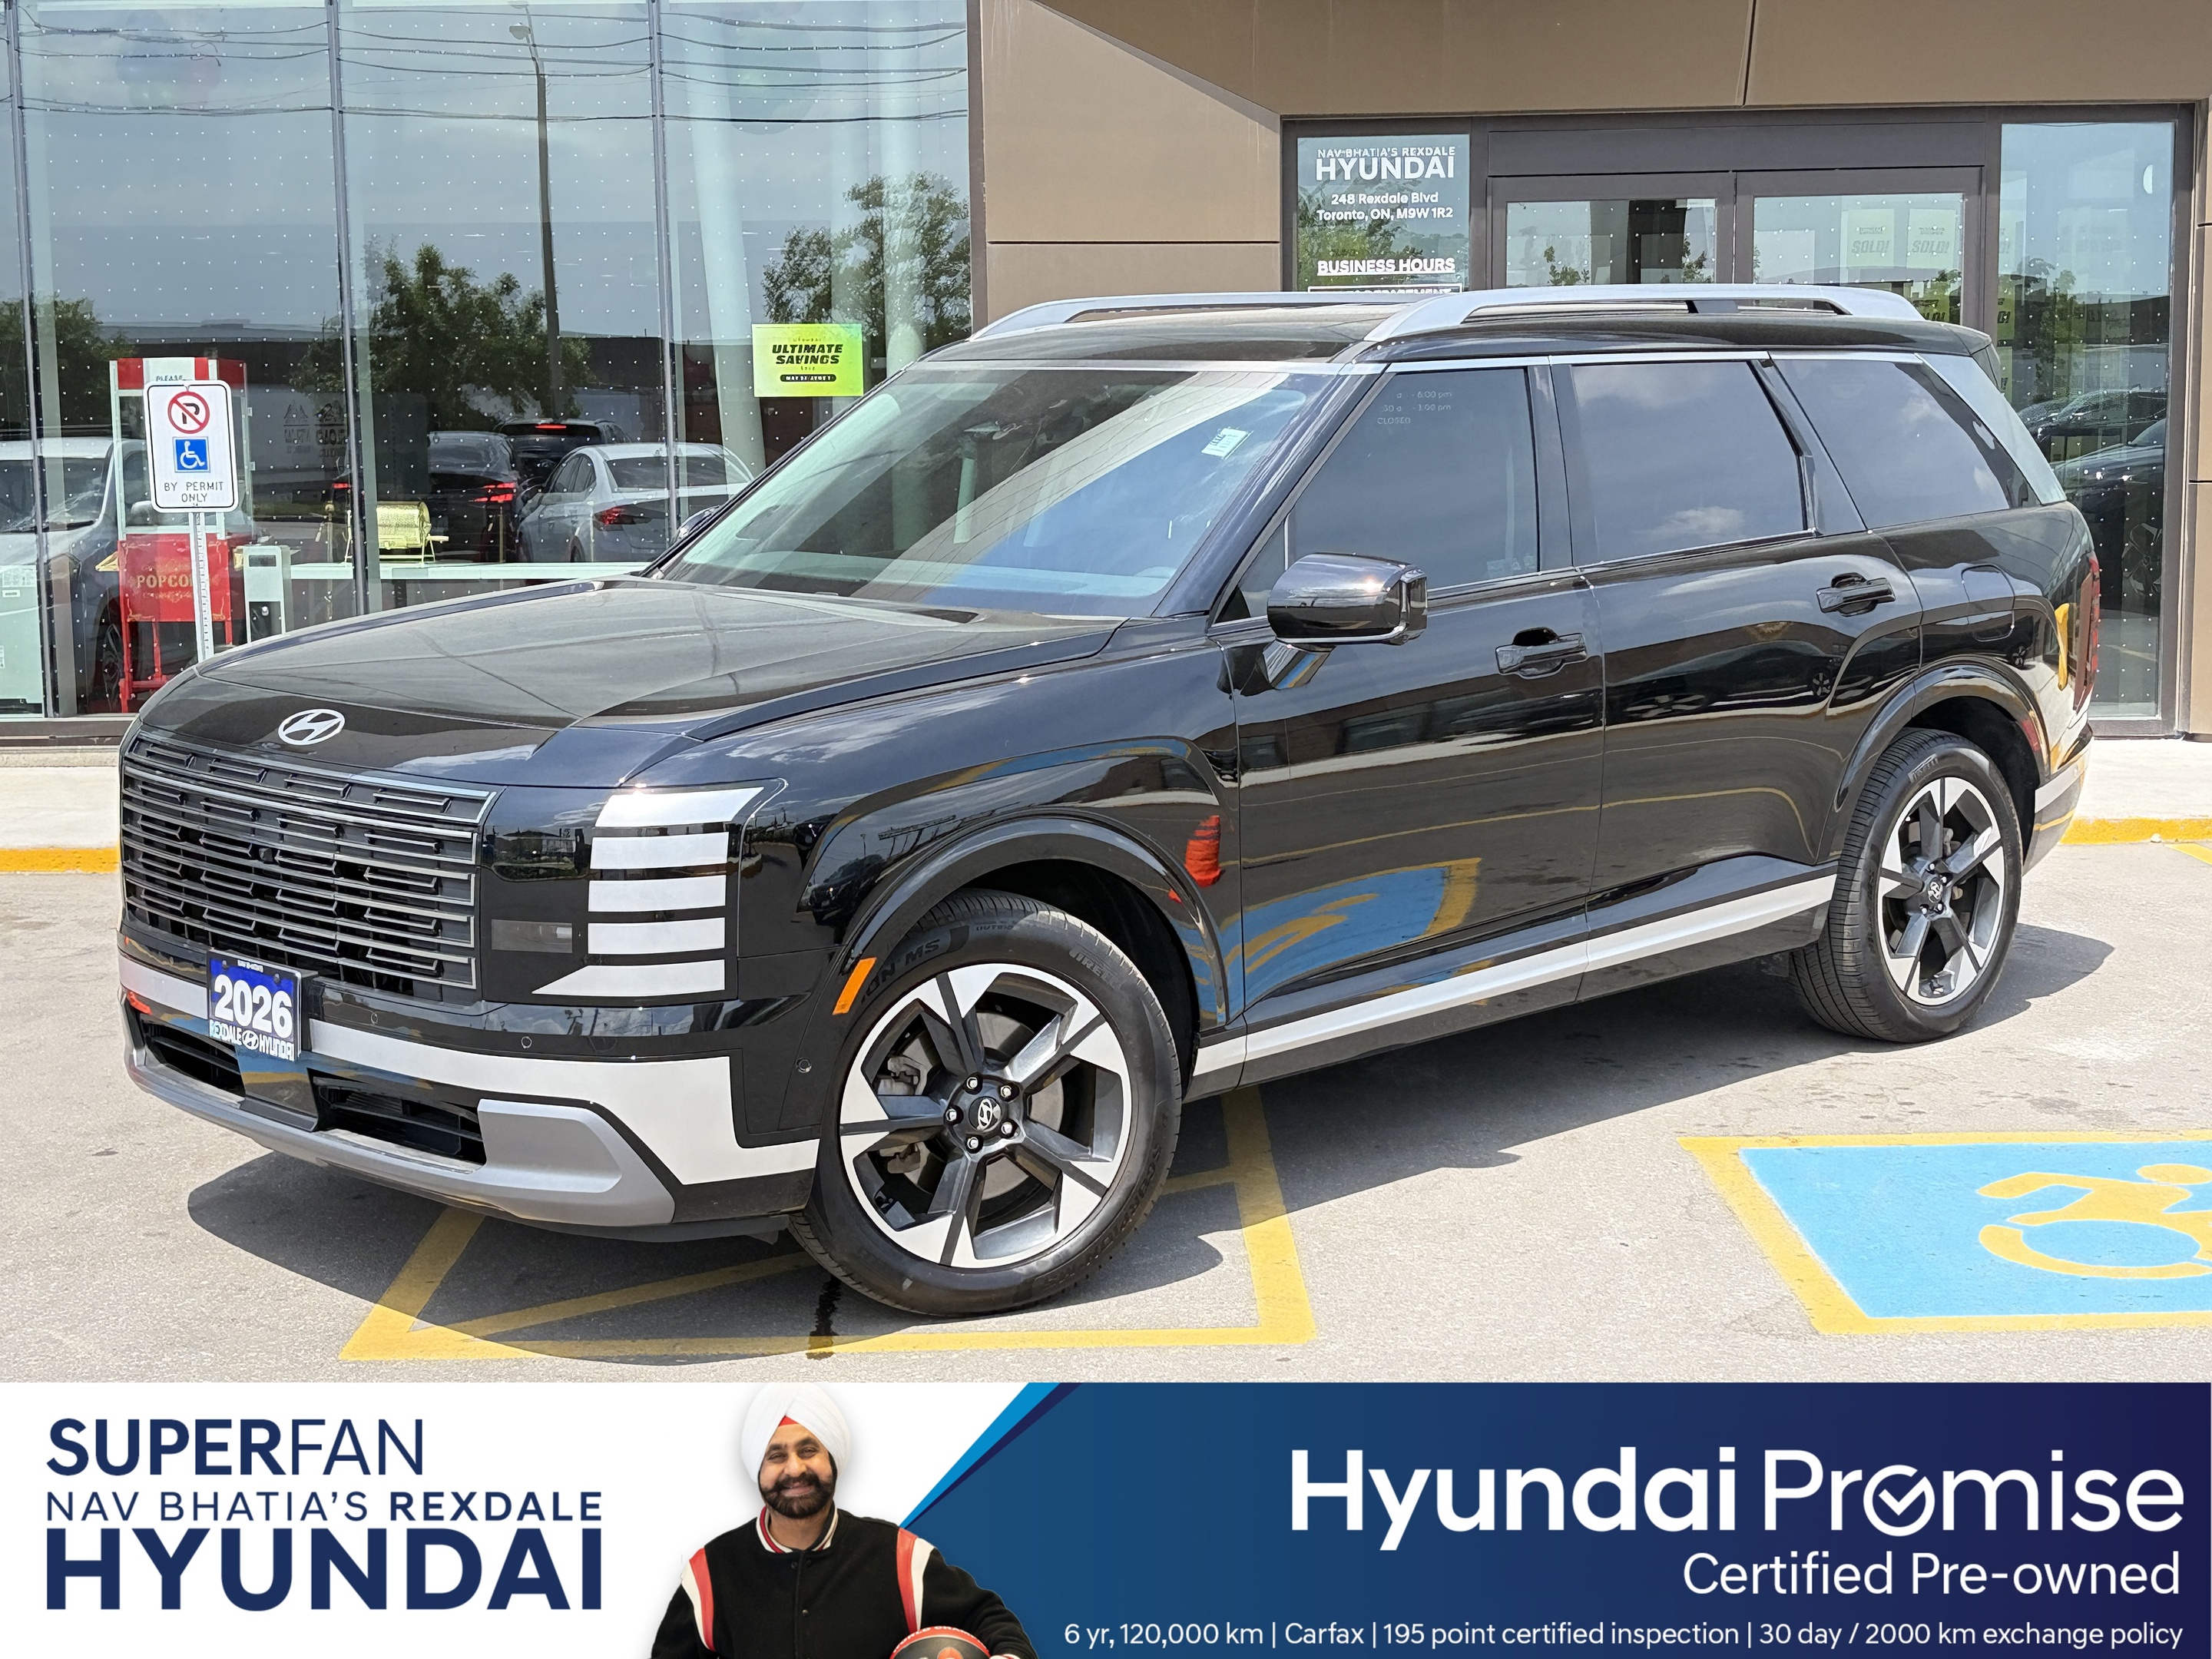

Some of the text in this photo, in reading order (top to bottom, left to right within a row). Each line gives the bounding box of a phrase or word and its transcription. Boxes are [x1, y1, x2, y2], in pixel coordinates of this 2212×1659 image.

[1317, 149, 1343, 158] NAV
[1402, 146, 1455, 157] REXDALE
[1316, 155, 1455, 181] HYUNDAI
[1331, 191, 1439, 204] 248 Rexdale Blvd
[1316, 207, 1453, 221] Toronto, ON, M9W 1R2
[1852, 240, 1889, 253] SOLD!
[1912, 240, 1950, 253] SOLD!
[1317, 257, 1455, 275] BUSINESS HOURS
[772, 344, 843, 353] ULTIMATE
[776, 355, 840, 364] SAVINGS
[164, 482, 224, 492] BY PERMIT
[181, 493, 207, 502] ONLY
[137, 574, 193, 588] POPCO
[906, 939, 940, 965] MS
[214, 974, 293, 1038] 2026
[259, 1033, 295, 1061] HYUNDAI
